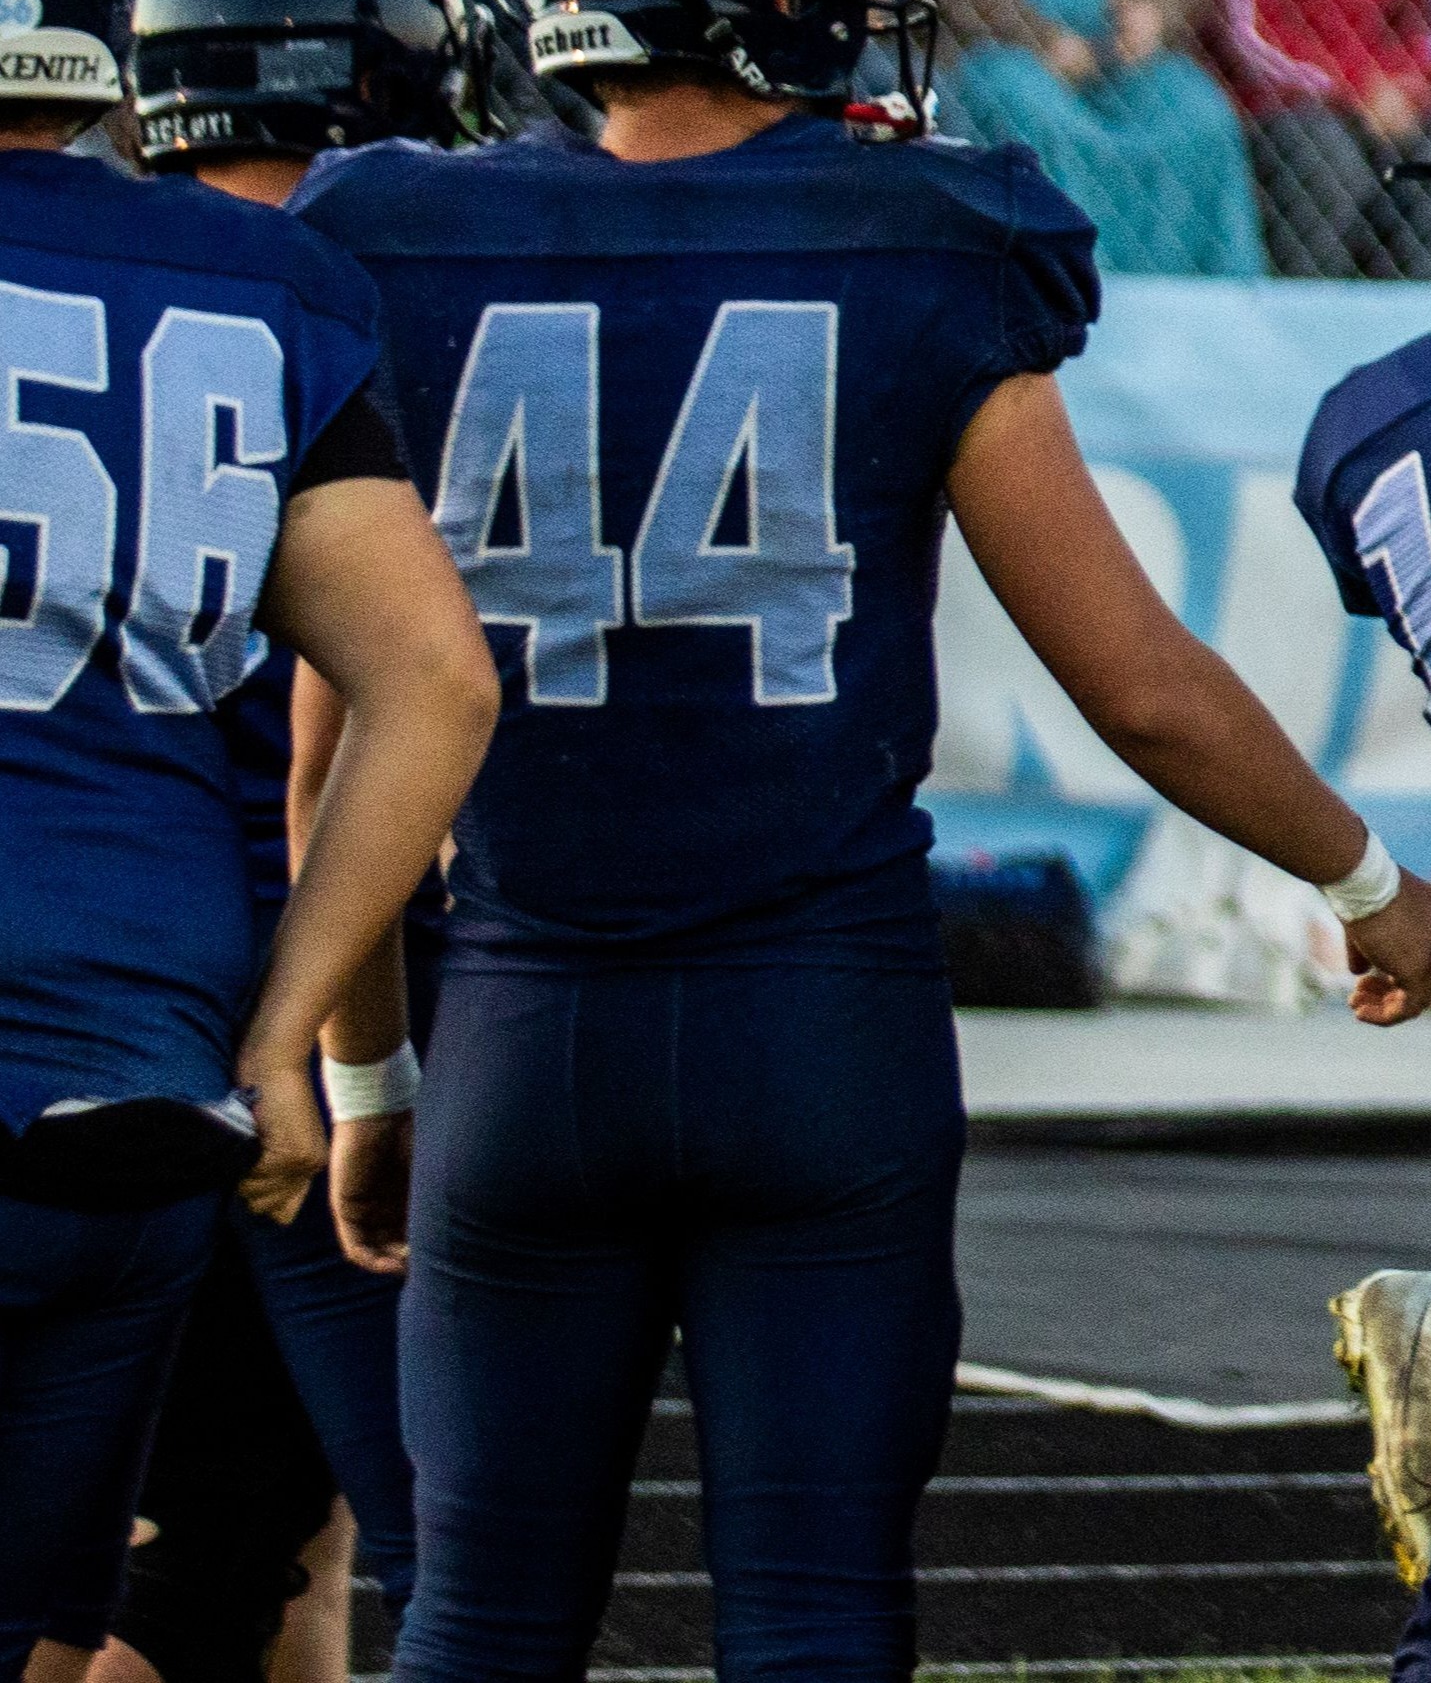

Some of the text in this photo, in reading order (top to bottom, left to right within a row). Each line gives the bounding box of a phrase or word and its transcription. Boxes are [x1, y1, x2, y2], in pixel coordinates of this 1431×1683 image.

[534, 22, 611, 57] schutt
[0, 281, 287, 714] 56
[432, 301, 855, 707] 44
